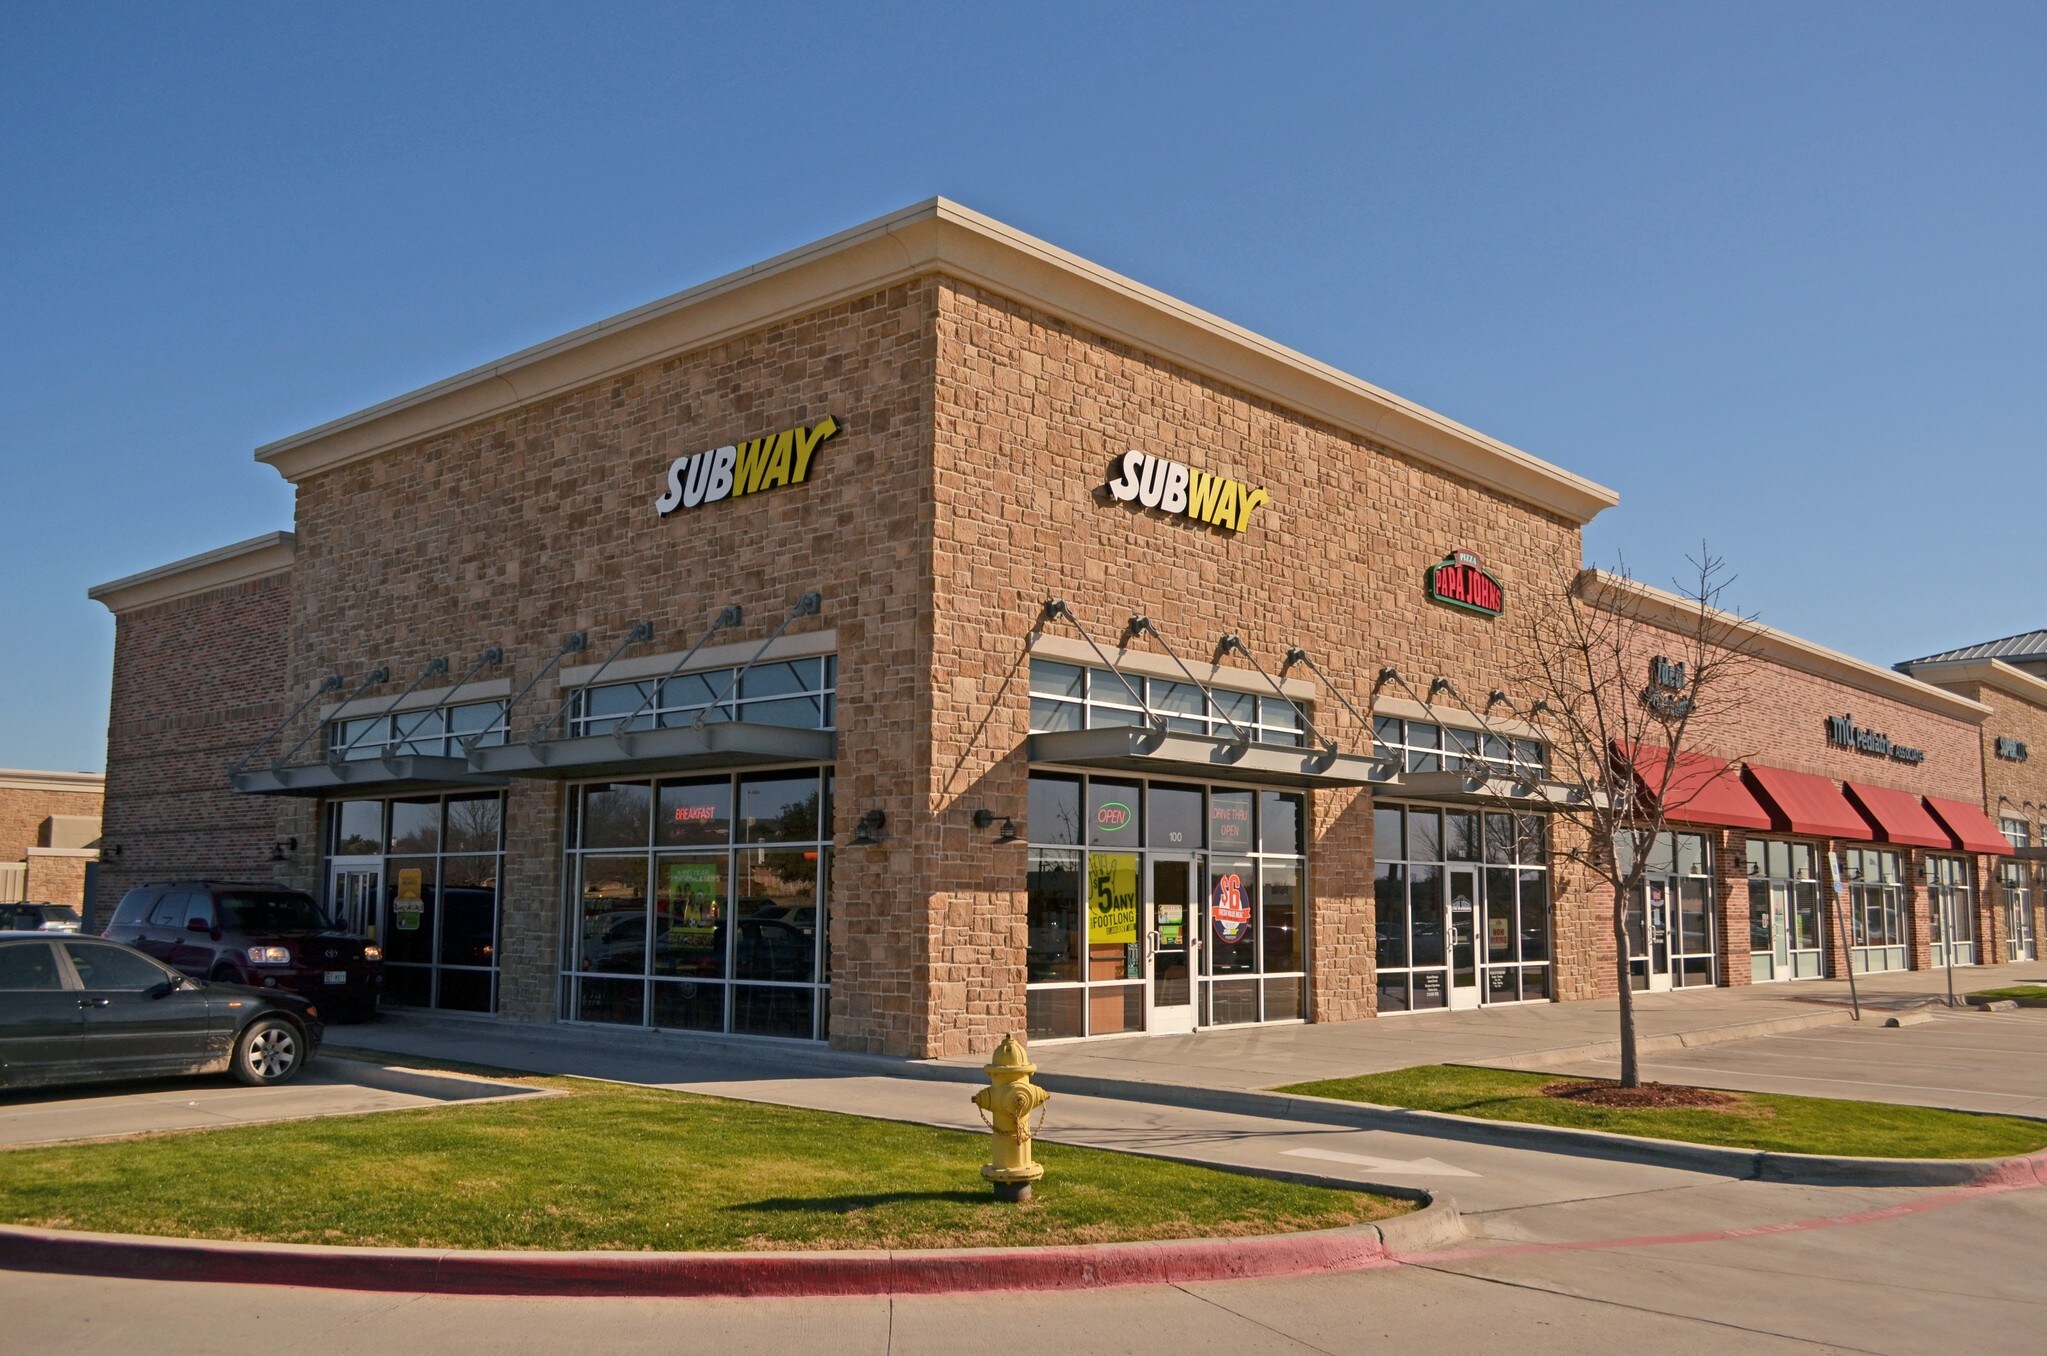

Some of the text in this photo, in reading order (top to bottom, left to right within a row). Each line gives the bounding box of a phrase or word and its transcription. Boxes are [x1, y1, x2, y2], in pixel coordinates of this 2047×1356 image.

[655, 415, 838, 517] SUBWAY
[1109, 450, 1271, 533] SUBWAY
[1460, 553, 1477, 565] PIZZA
[1436, 566, 1465, 601] PAPA
[675, 806, 715, 820] BREAKFAST
[1097, 808, 1126, 824] OPEN
[1169, 831, 1182, 843] 100
[1220, 824, 1239, 836] OPEN
[1220, 873, 1240, 910] $6
[1113, 893, 1135, 912] ANY
[1093, 911, 1134, 929] FOOTLONG
[1492, 928, 1505, 936] NOW
